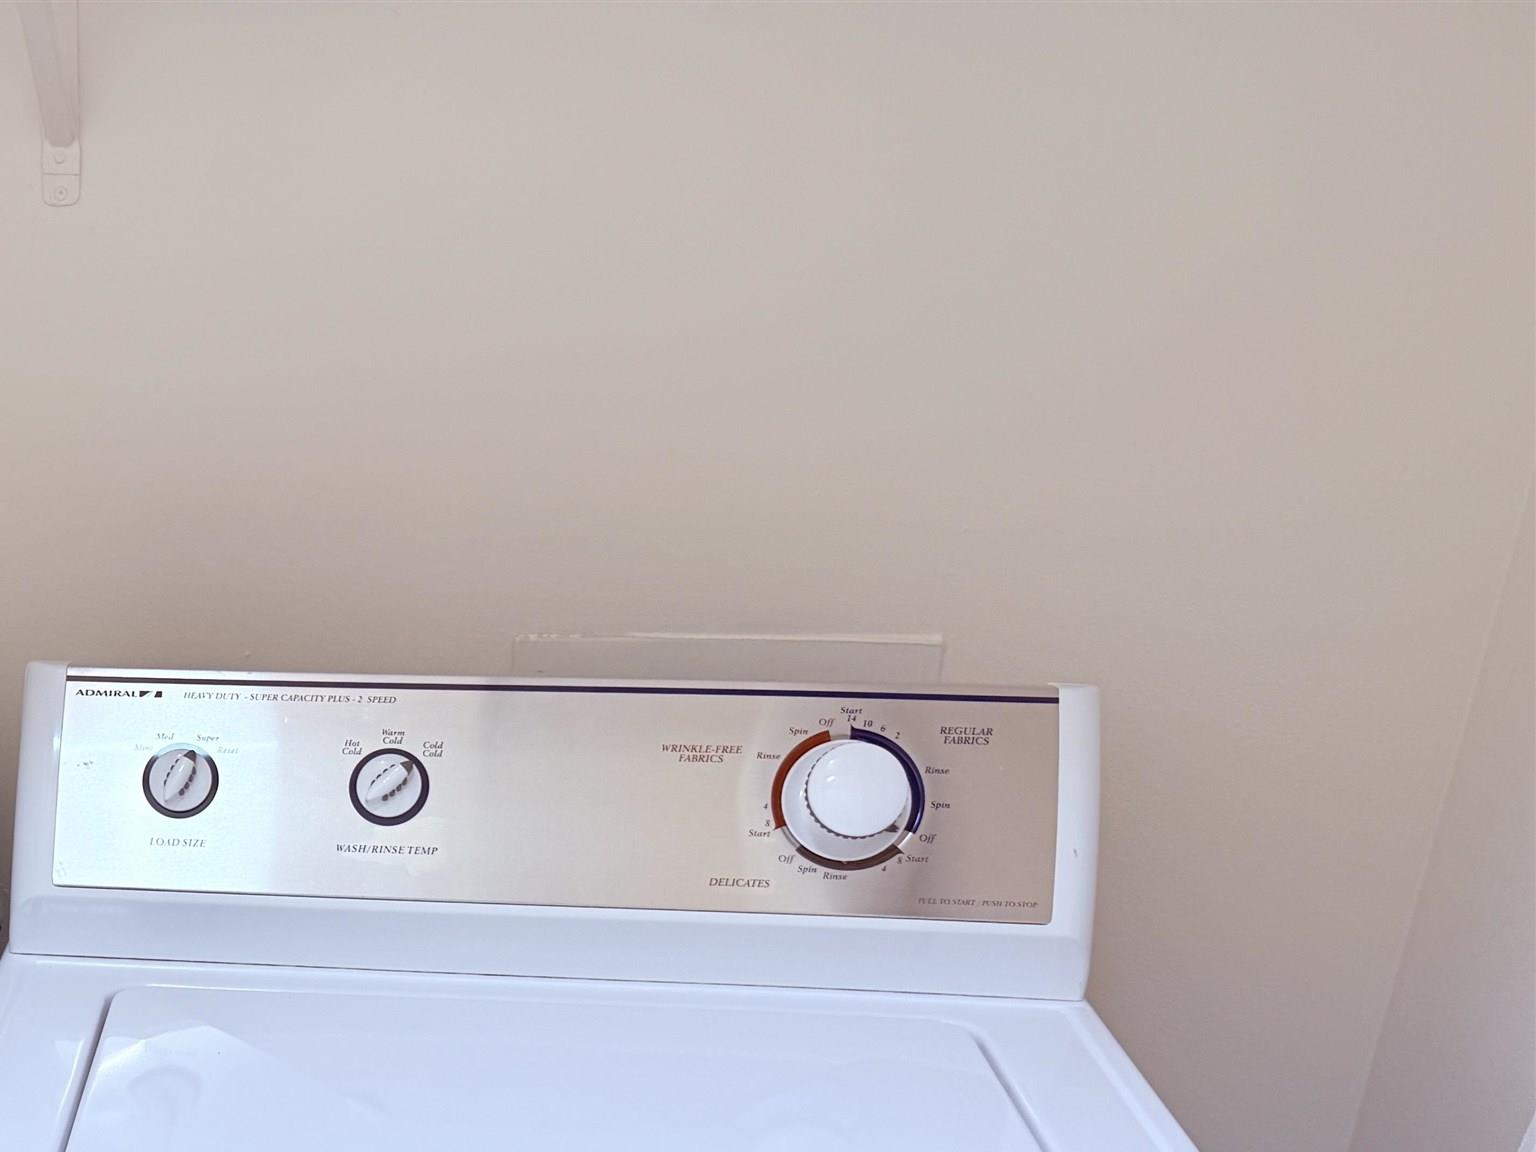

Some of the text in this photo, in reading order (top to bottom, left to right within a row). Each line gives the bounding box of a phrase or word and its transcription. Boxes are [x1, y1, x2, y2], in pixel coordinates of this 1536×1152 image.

[75, 689, 138, 698] ADMIRAL
[182, 691, 214, 700] HEAVY
[215, 692, 242, 701] DUTY
[249, 693, 279, 702] SUPER
[280, 694, 327, 703] CAPACITY
[327, 695, 351, 703] PLUS
[367, 696, 398, 704] SPEED
[840, 706, 863, 715] Start
[818, 718, 836, 728] Off
[847, 715, 857, 723] 14
[863, 720, 873, 728] 10
[381, 729, 405, 737] Warm
[788, 727, 809, 737] Spin
[894, 731, 901, 740] 2
[939, 726, 994, 737] REGULAR
[196, 734, 220, 742] Super
[382, 736, 404, 745] Cold
[943, 736, 990, 746] FABRICS
[344, 739, 360, 747] Hot
[422, 741, 445, 750] Cold
[342, 747, 363, 756] Cold
[422, 749, 444, 758] Cold
[661, 743, 744, 755] WRINKLE-FREE
[678, 754, 725, 763] FABRICS
[756, 751, 781, 760] Rinse
[924, 766, 950, 775] Rinse
[930, 800, 951, 810] Spin
[748, 829, 771, 838] Start
[149, 837, 207, 848] LOAD SIZE
[919, 834, 937, 844] Off
[336, 844, 439, 856] WASH/RINSE TEMP
[778, 854, 796, 865] Off
[905, 855, 929, 863] Start
[797, 865, 817, 875] Spin
[822, 872, 848, 881] Rinse
[708, 877, 771, 888] DELICATES
